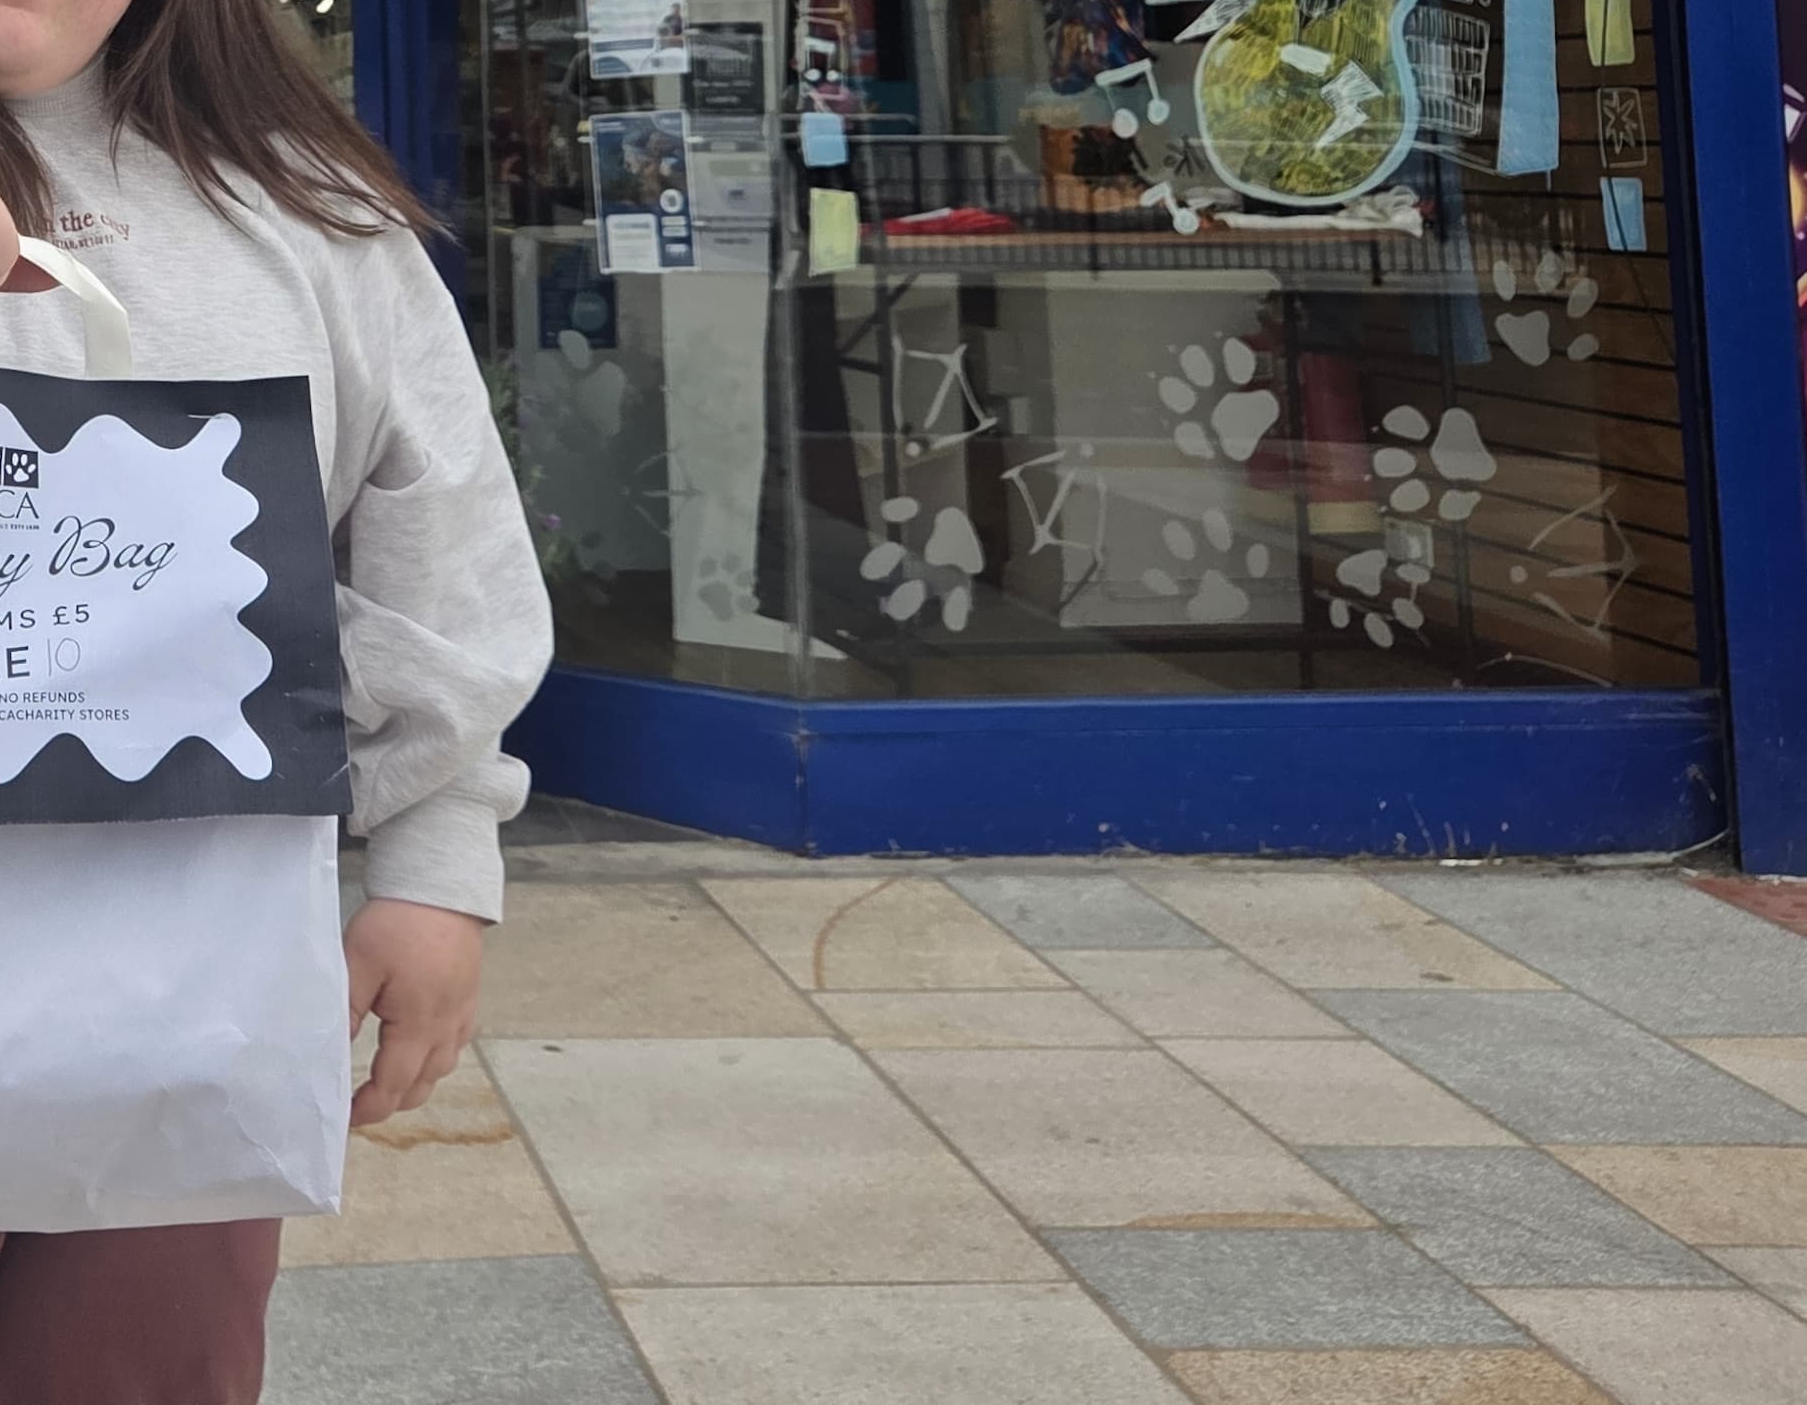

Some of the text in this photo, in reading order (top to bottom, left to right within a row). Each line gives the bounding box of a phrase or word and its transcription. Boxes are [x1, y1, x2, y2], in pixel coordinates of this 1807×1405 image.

[59, 209, 94, 232] the
[49, 514, 179, 590] Bag
[52, 603, 90, 626] £5
[46, 637, 81, 677] 10
[22, 691, 86, 704] REFUNDS
[79, 708, 130, 722] STORES
